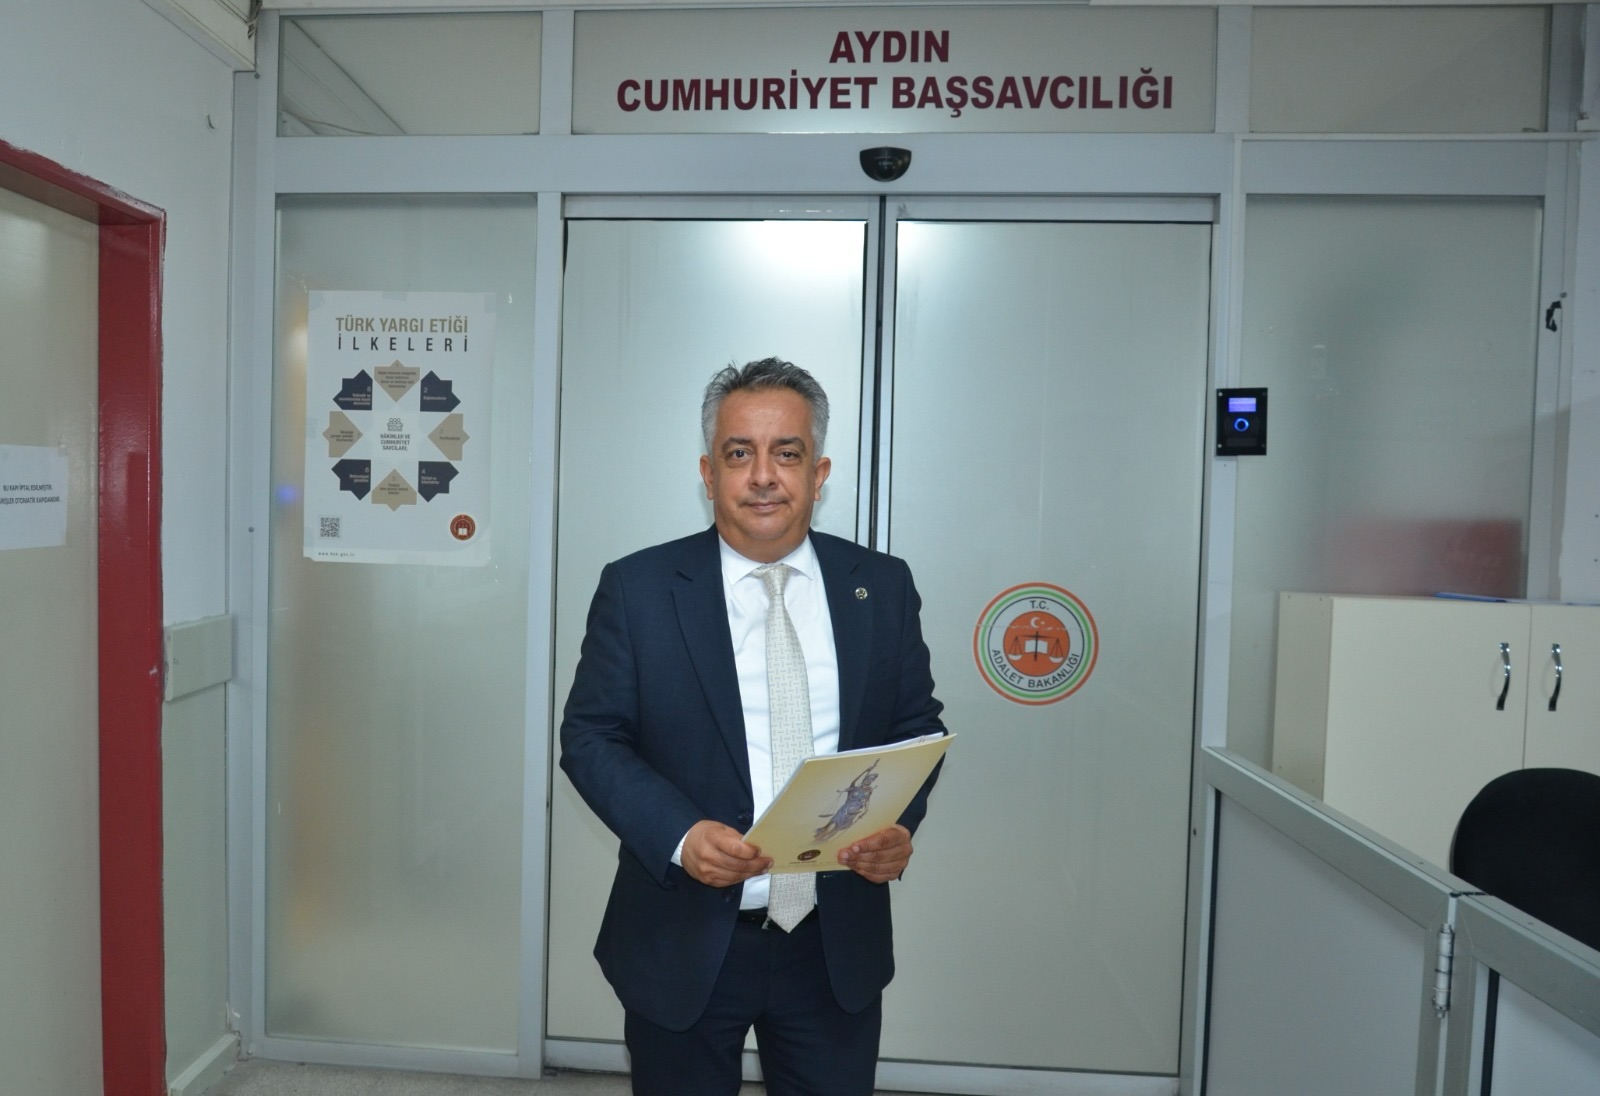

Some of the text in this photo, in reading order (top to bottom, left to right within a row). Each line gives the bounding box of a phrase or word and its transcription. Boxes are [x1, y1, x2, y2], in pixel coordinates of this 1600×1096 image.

[829, 30, 950, 63] AYDIN
[616, 67, 1173, 118] CUMHURİYET BAŞSAVCILIĞI
[336, 314, 468, 333] TÜRK YARGI ETİĞİ
[338, 333, 468, 352] İLKELERİ
[1029, 600, 1050, 610] T.C.
[992, 649, 1024, 684] ADALET
